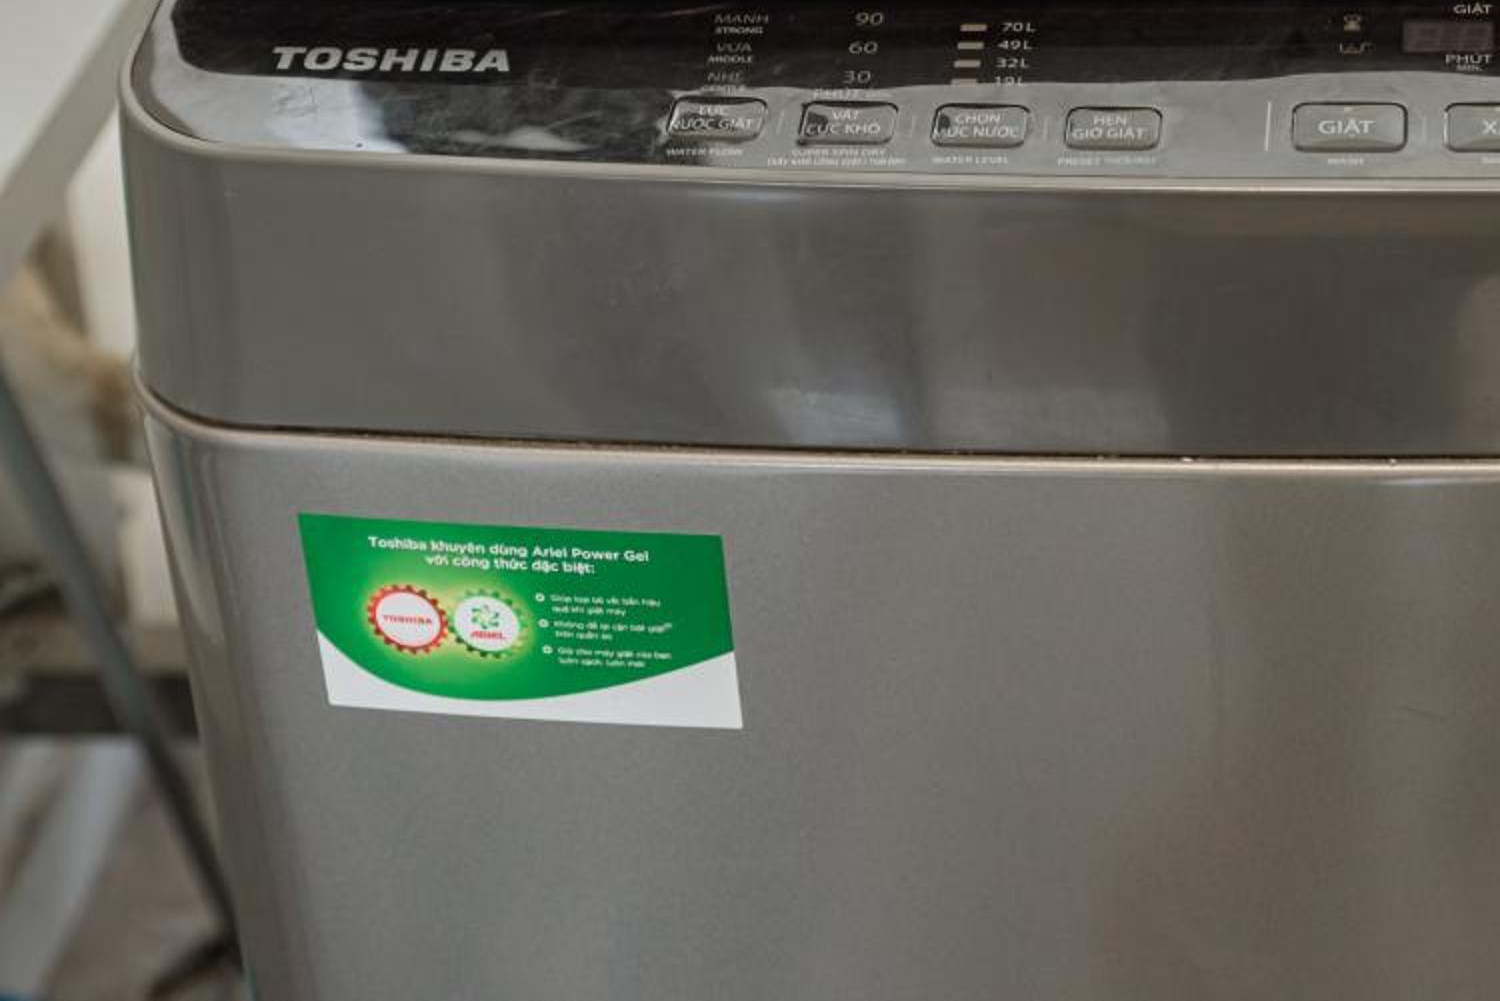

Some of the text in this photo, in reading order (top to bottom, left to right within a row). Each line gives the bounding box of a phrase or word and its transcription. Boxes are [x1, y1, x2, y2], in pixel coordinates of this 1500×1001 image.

[854, 11, 884, 27] 90
[714, 25, 764, 35] STRONG
[848, 40, 879, 55] 60
[272, 46, 511, 73] TOSHIBA
[843, 69, 873, 84] 30
[367, 535, 427, 551] Toshiba
[532, 545, 567, 559] Ariel
[571, 547, 619, 561] Power
[622, 549, 650, 562] Gel
